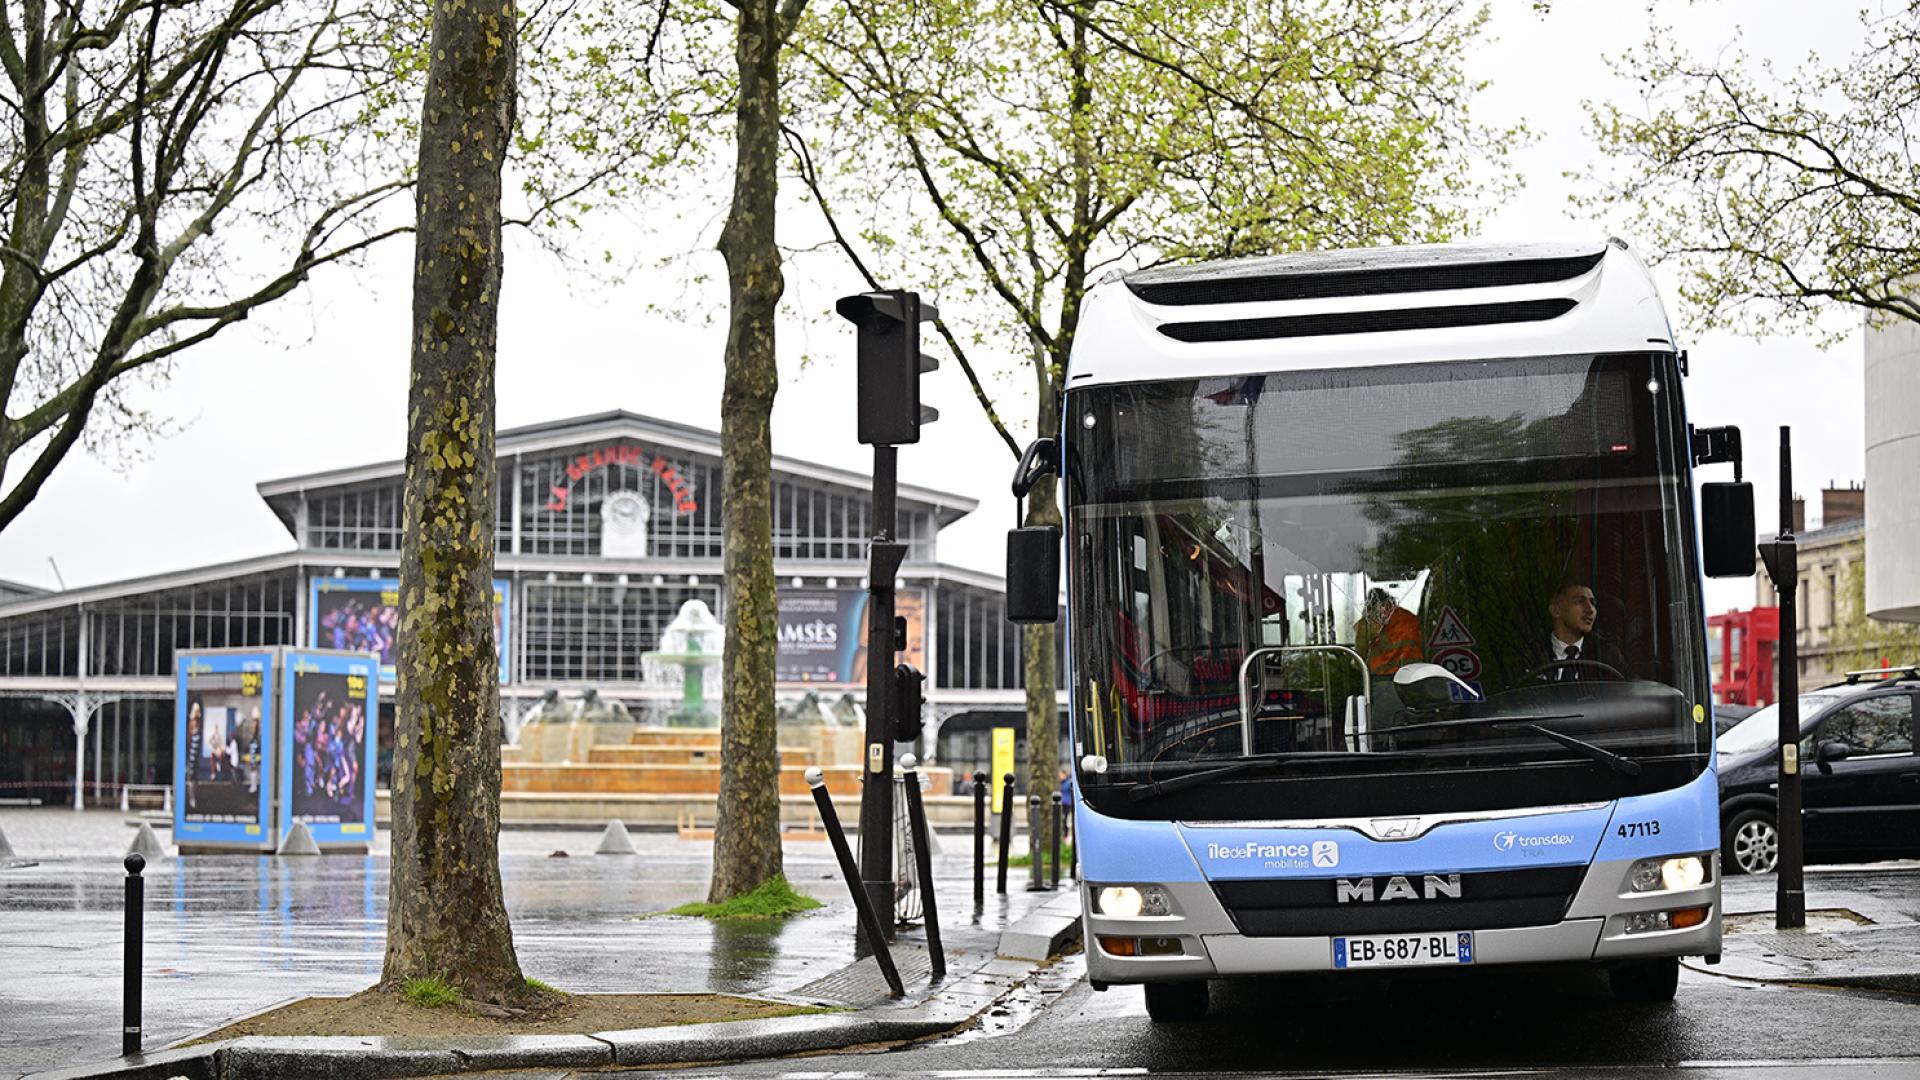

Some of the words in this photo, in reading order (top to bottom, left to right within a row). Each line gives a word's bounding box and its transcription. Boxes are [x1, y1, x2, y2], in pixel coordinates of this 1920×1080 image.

[545, 487, 568, 512] LA
[566, 445, 643, 481] GRANDE
[1617, 820, 1661, 838] 47113
[1519, 833, 1574, 846] transdev
[1522, 849, 1545, 857] TRA
[1336, 874, 1461, 902] MAN
[1350, 937, 1456, 961] EB-687-BL
[1459, 947, 1470, 958] 74
